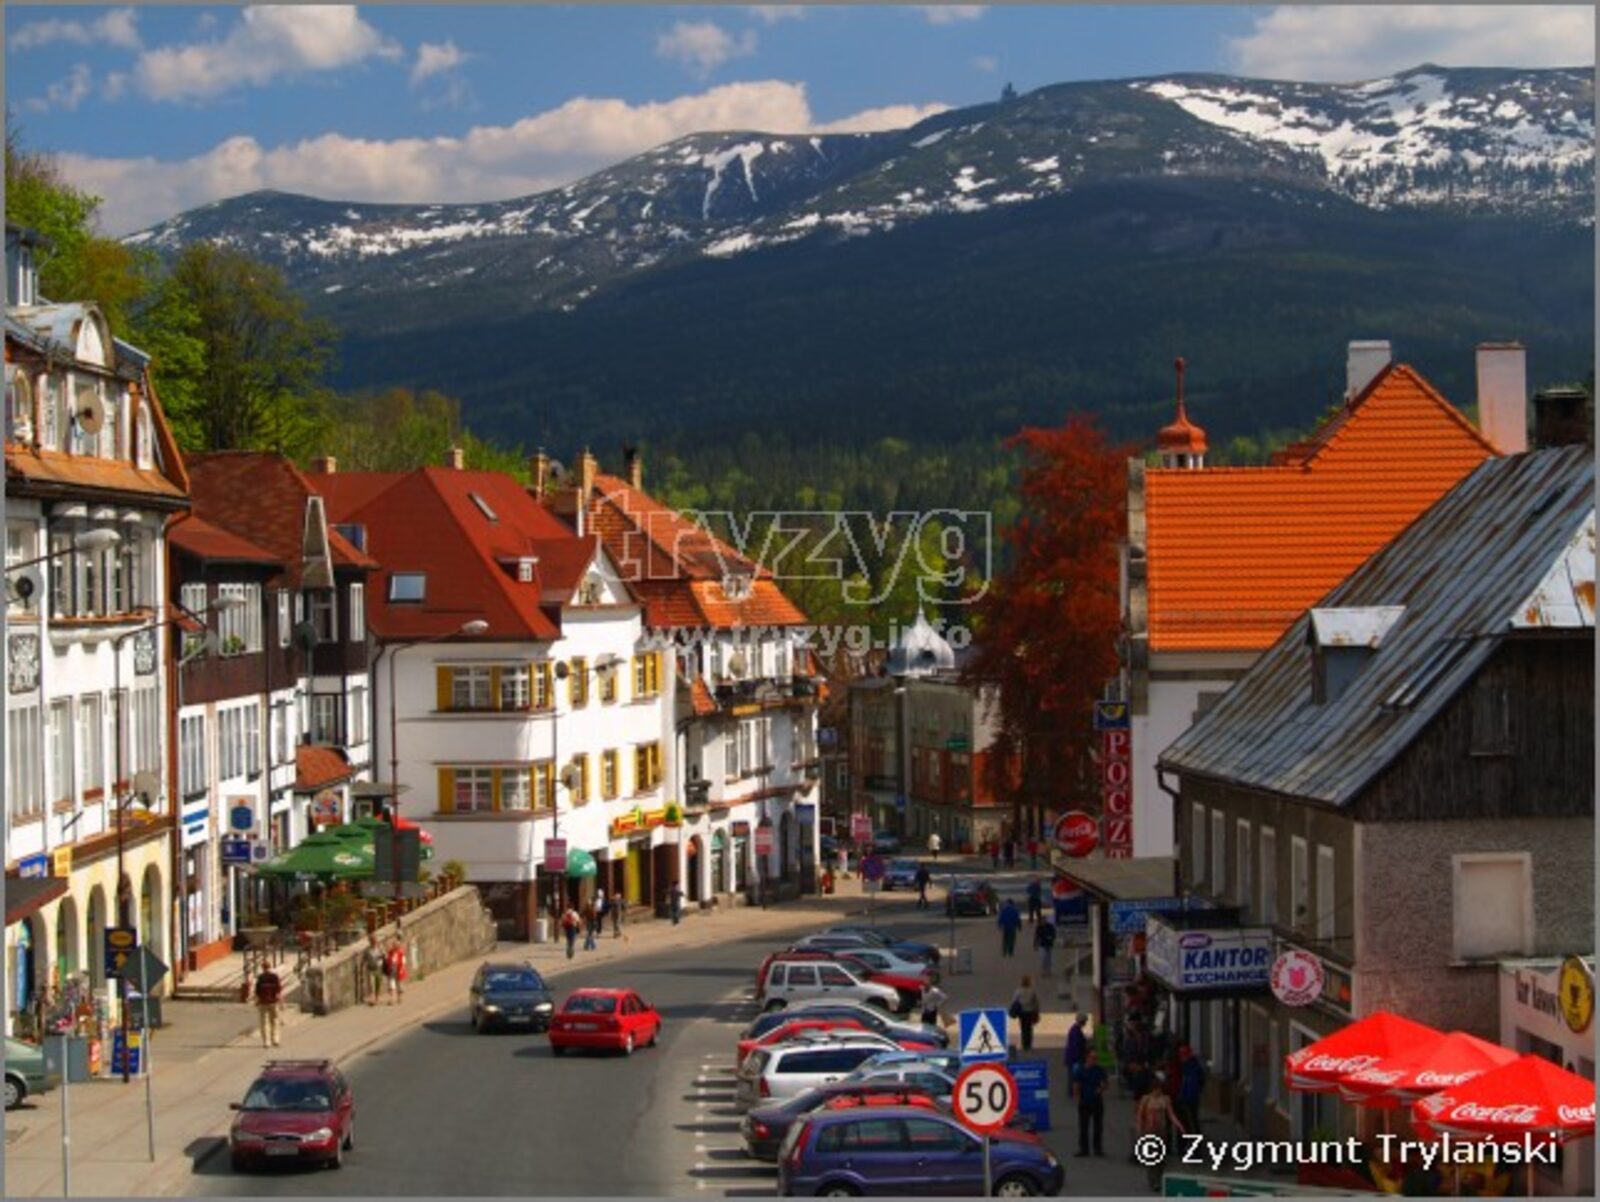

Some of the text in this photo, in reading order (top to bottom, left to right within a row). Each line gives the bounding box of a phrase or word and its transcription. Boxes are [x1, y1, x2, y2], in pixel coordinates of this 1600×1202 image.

[1184, 947, 1267, 971] KANTOR
[1183, 969, 1269, 985] EXCHANGE
[966, 1080, 1008, 1114] 50
